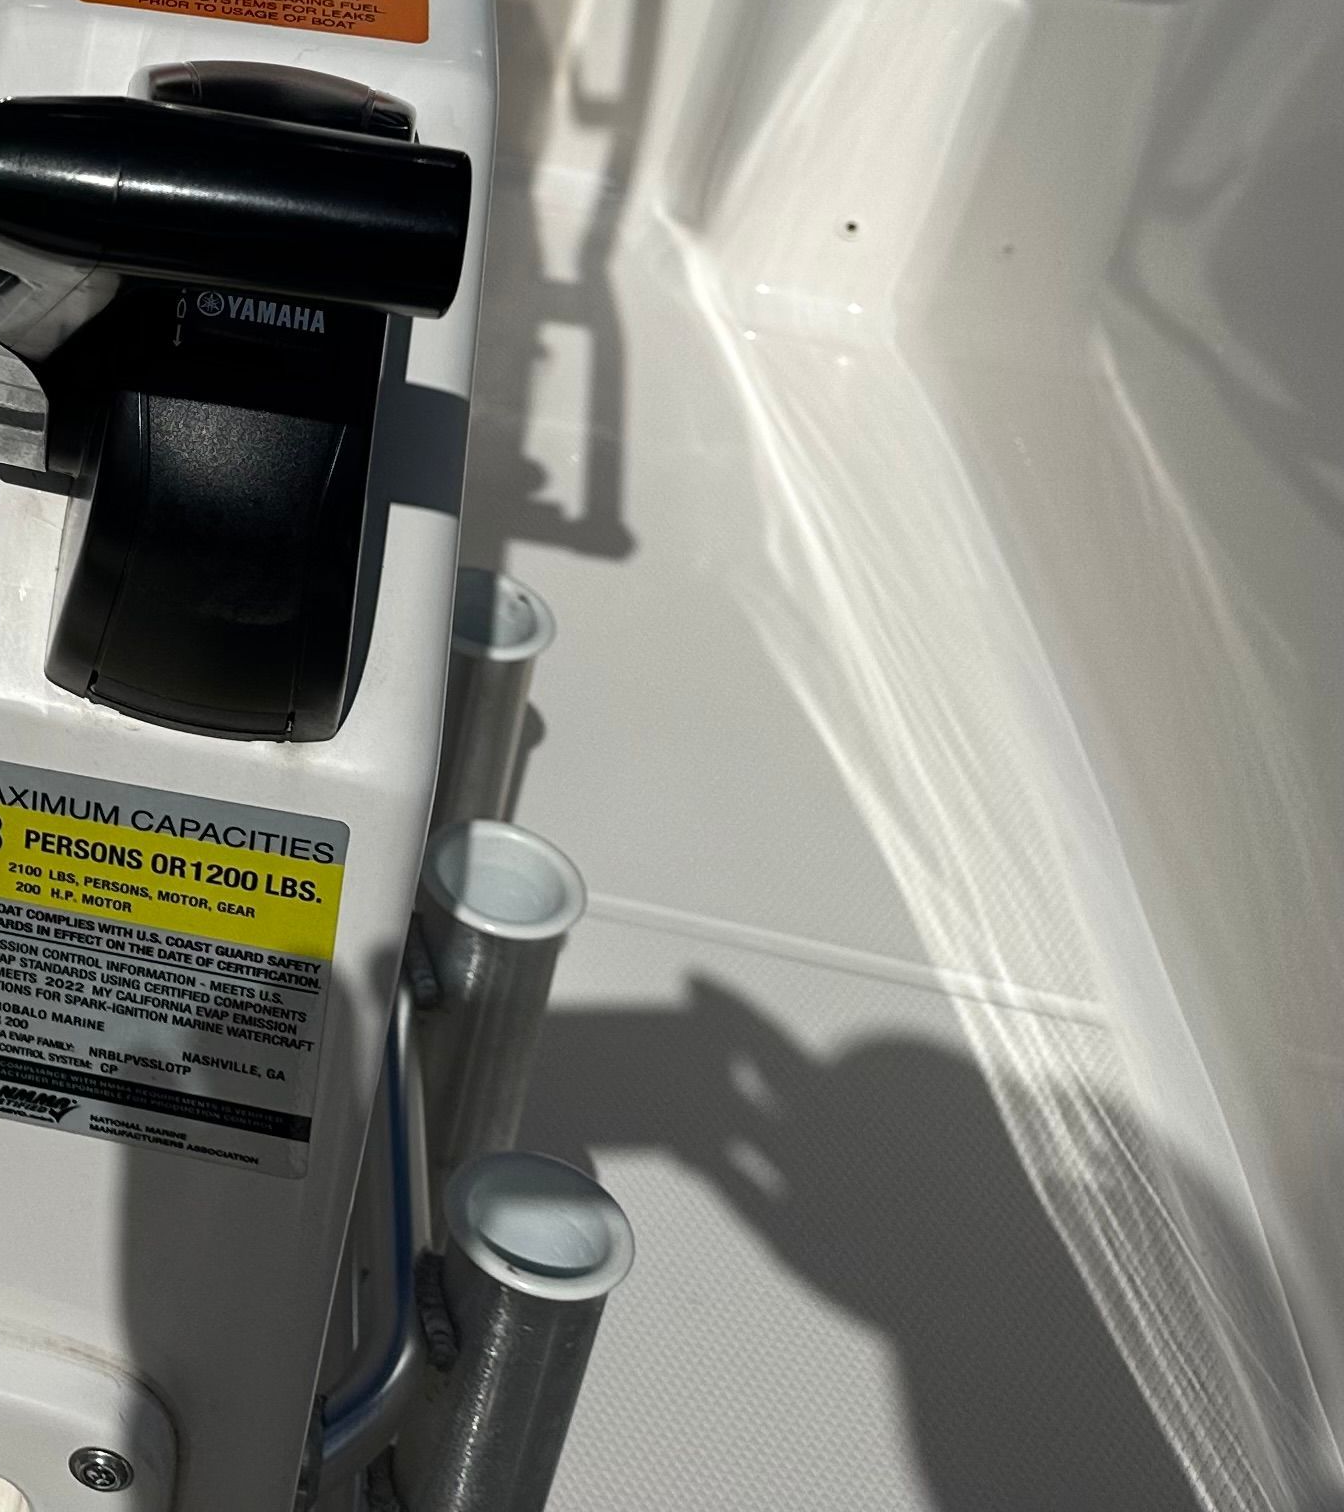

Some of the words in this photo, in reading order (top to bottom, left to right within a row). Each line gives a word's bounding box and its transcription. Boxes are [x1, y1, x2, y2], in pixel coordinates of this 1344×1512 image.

[196, 2, 215, 12] TO
[220, 5, 279, 21] USAGE
[285, 13, 307, 24] OF
[312, 16, 355, 30] BOAT
[281, 3, 315, 15] FOR
[321, 8, 375, 23] LEAKS
[227, 295, 325, 334] YAMAHA
[129, 808, 335, 865] CAPACITIES
[23, 829, 143, 870] PERSONS
[150, 853, 187, 879] OR
[192, 860, 259, 892] 1200
[263, 874, 324, 904] LBS.
[7, 861, 42, 878] 2100
[48, 869, 79, 886] LBS,
[83, 876, 153, 901] PERSONS,
[156, 889, 212, 912] MOTOR,
[216, 900, 255, 918] GEAR
[14, 880, 41, 895] 200
[50, 887, 78, 902] H.P.
[81, 893, 132, 913] MOTOR
[25, 908, 95, 931] COMPLIES
[97, 921, 133, 939] WITH
[135, 929, 162, 944] U.S.
[165, 935, 211, 954] COAST
[214, 944, 264, 964] GUARD
[266, 954, 321, 975] SAFETY
[36, 924, 50, 937] IN
[53, 927, 102, 947] EFFECT
[105, 937, 124, 951] ON
[127, 942, 154, 957] THE
[157, 948, 192, 965] DATE
[194, 955, 213, 969] OF
[215, 959, 322, 990] CERTIFICATION.
[19, 956, 97, 982] STANDARDS
[100, 972, 140, 991] USING
[143, 980, 210, 1004] CERTIFIED
[212, 994, 307, 1023] COMPONENTS
[41, 947, 103, 969] CONTROL
[105, 959, 196, 987] INFORMATION
[208, 979, 256, 999] MEETS
[258, 989, 284, 1004] U.S.
[3, 1015, 28, 1030] 200
[34, 987, 60, 1002] FOR
[63, 993, 168, 1024] SPARK-IGNITION
[171, 1014, 223, 1035] MARINE
[225, 1025, 314, 1053] WATERCRAFT
[44, 976, 84, 993] 2022
[91, 985, 112, 999] MY
[114, 989, 192, 1015] CALIFORNIA
[195, 1005, 229, 1022] EVAP
[231, 1012, 297, 1036] EMISSION
[50, 1011, 105, 1032] MARINE
[9, 1030, 35, 1044] EVAP
[181, 1050, 262, 1078] NASHVILLE,
[265, 1068, 286, 1082] GA
[144, 1125, 187, 1141] MARINE
[185, 1142, 259, 1165] ASSOCIATION
